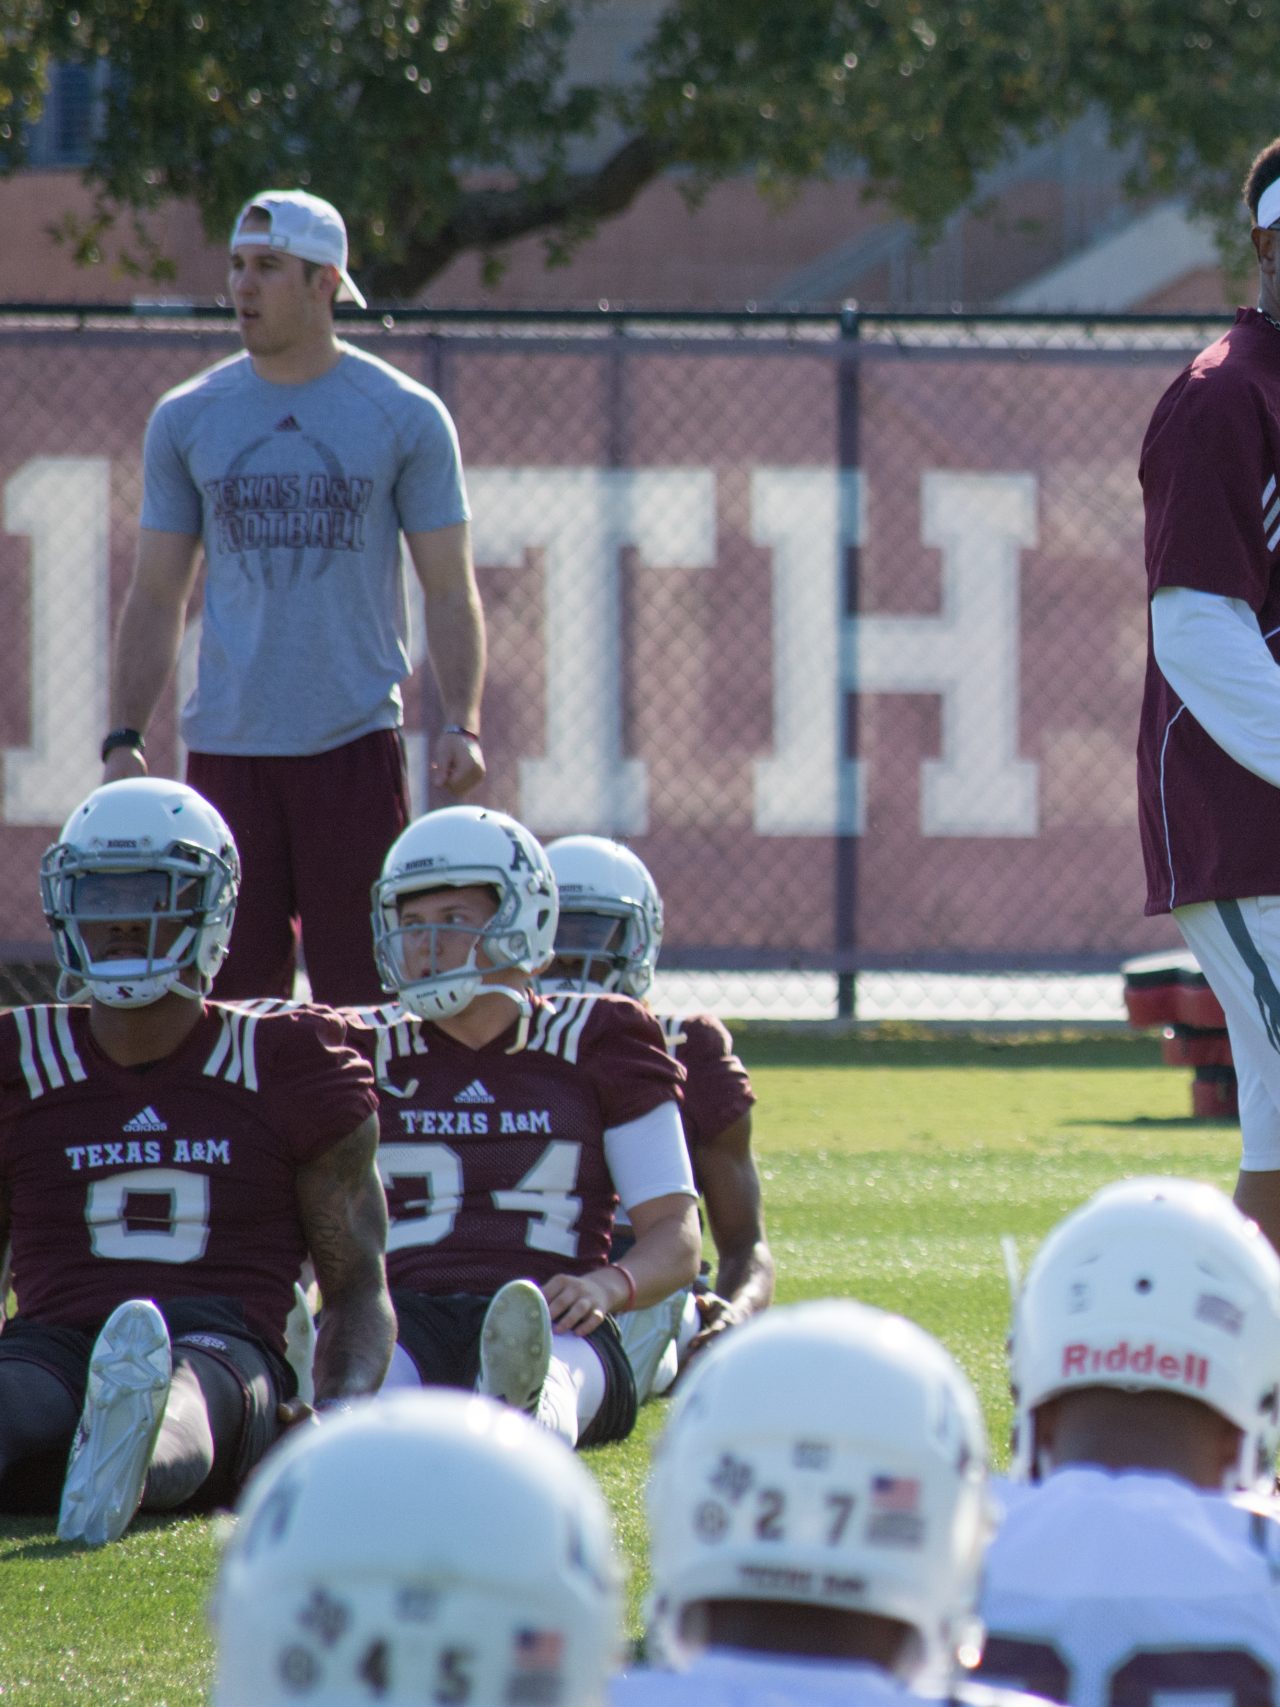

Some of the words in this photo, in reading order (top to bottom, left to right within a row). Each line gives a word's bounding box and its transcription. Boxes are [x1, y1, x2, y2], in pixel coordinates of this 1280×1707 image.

[204, 475, 299, 516] TEXAS
[308, 474, 374, 514] A&M
[122, 1121, 168, 1133] adidas
[399, 1109, 488, 1134] TEXAS
[499, 1110, 552, 1134] A&M
[64, 1141, 162, 1171] TEXAS
[172, 1139, 231, 1165] A&M
[83, 1167, 212, 1265] 0
[1060, 1341, 1209, 1390] Riddell
